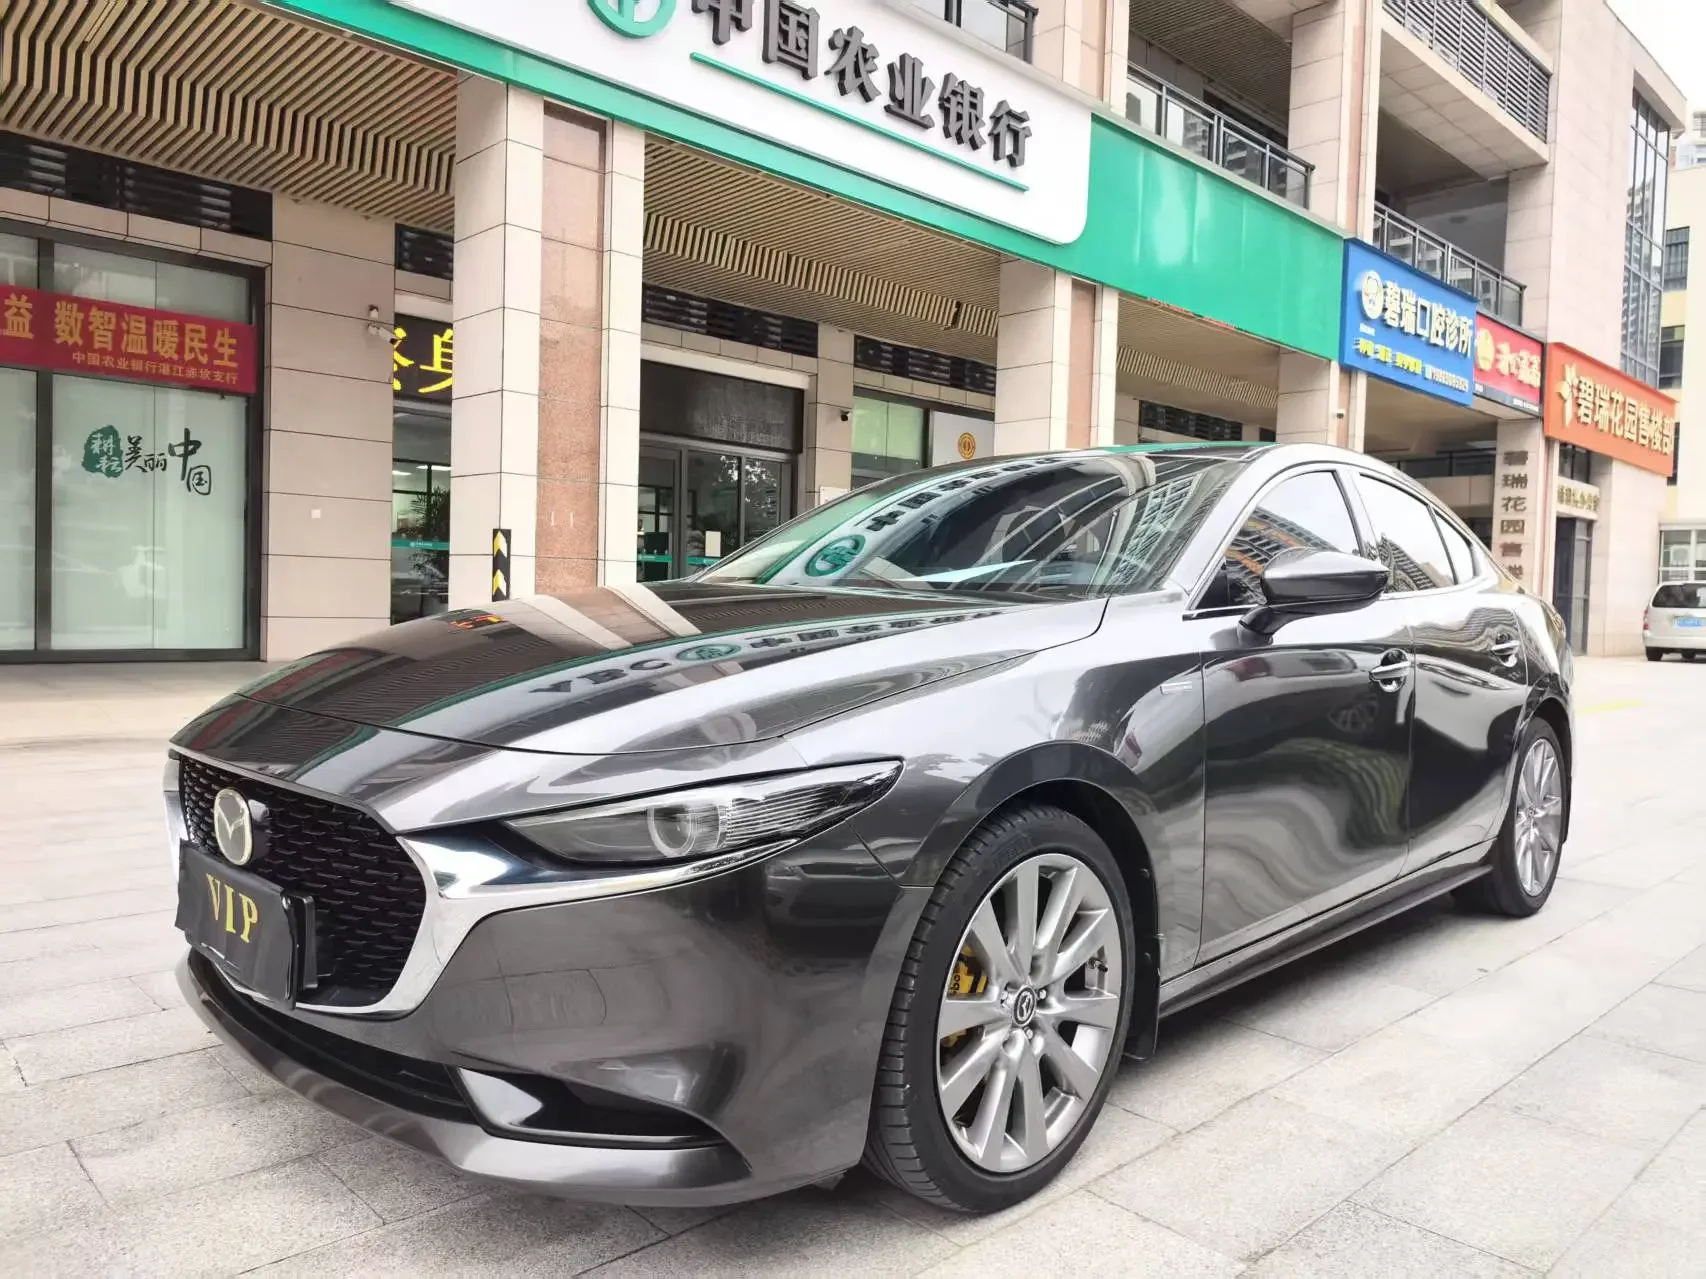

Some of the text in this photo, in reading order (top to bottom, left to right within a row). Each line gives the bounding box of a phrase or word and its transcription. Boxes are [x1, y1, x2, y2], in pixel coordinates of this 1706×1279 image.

[0, 293, 239, 368] 益 数智温暖民生
[1384, 280, 1473, 359] 碧瑞口腔诊所
[1577, 374, 1675, 456] 碧瑞花园售楼部
[124, 427, 212, 496] 美丽中国
[206, 872, 259, 944] VIP
